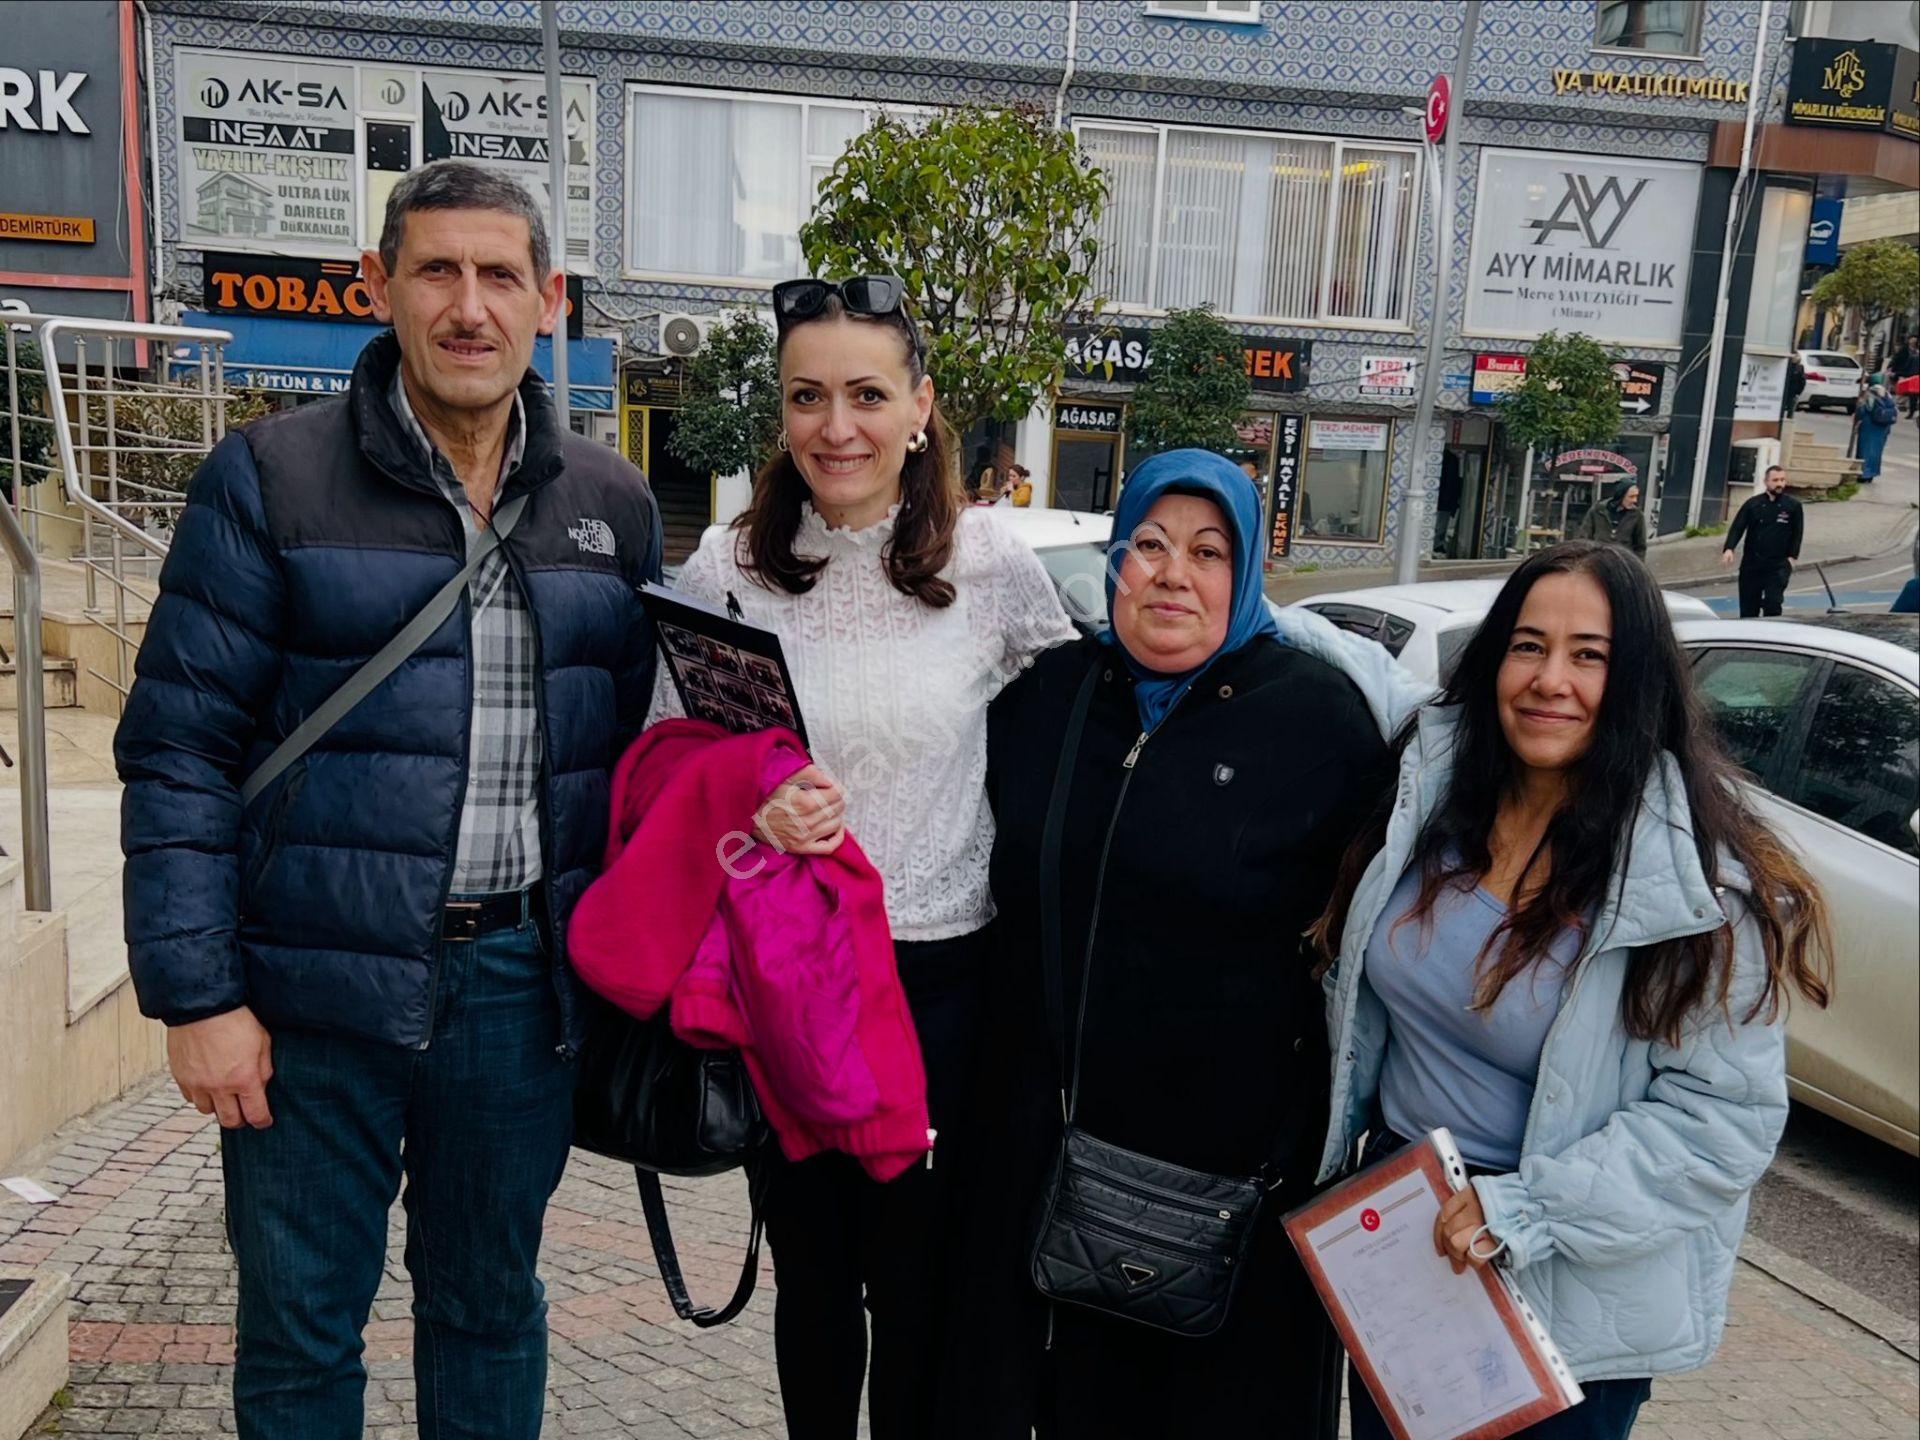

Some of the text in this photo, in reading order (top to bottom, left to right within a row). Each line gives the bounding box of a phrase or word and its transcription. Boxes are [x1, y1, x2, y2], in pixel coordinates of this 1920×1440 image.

[1554, 69, 1582, 96] YA
[237, 78, 347, 110] AK-SA
[278, 184, 350, 203] ULTRA LÜX
[1486, 252, 1676, 288] AYY MİMARLIK
[1487, 358, 1521, 372] Burak
[311, 377, 324, 391] &
[578, 517, 602, 531] THE
[567, 526, 602, 544] NORTH
[577, 538, 605, 554] FACE
